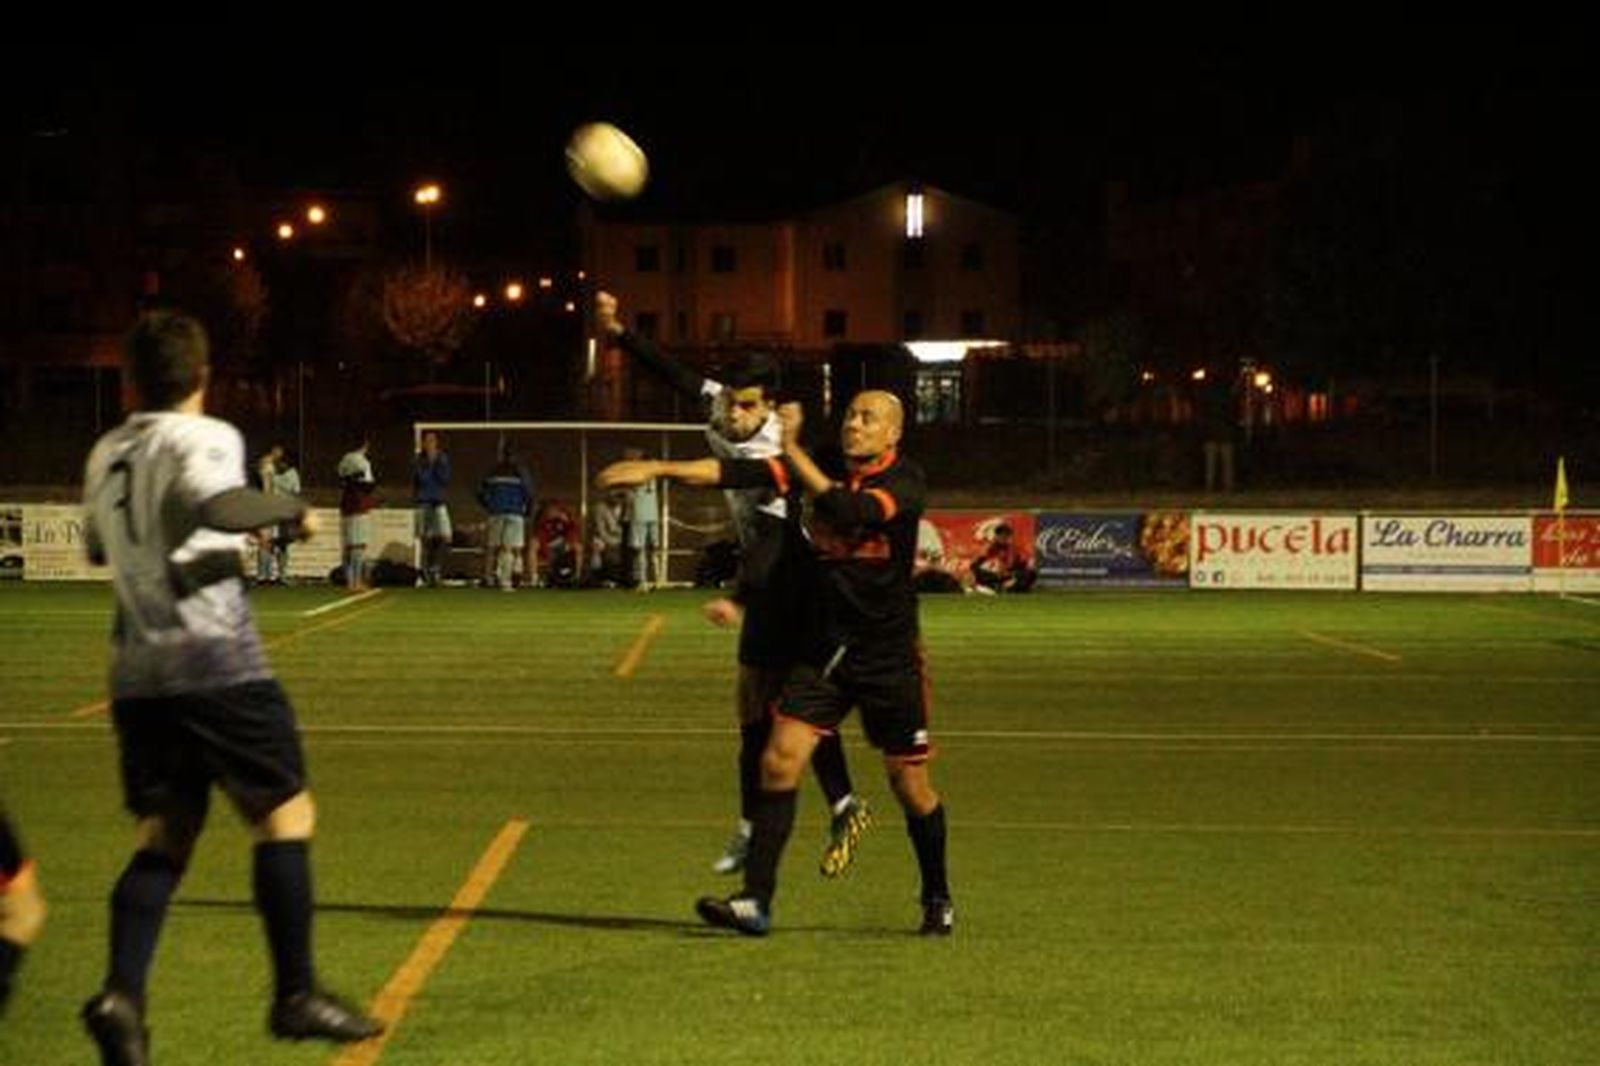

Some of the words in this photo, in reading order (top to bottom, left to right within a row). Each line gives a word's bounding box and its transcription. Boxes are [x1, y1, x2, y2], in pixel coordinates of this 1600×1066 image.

[1197, 519, 1351, 563] pucela
[1371, 520, 1419, 546] La
[1425, 520, 1525, 547] Charra
